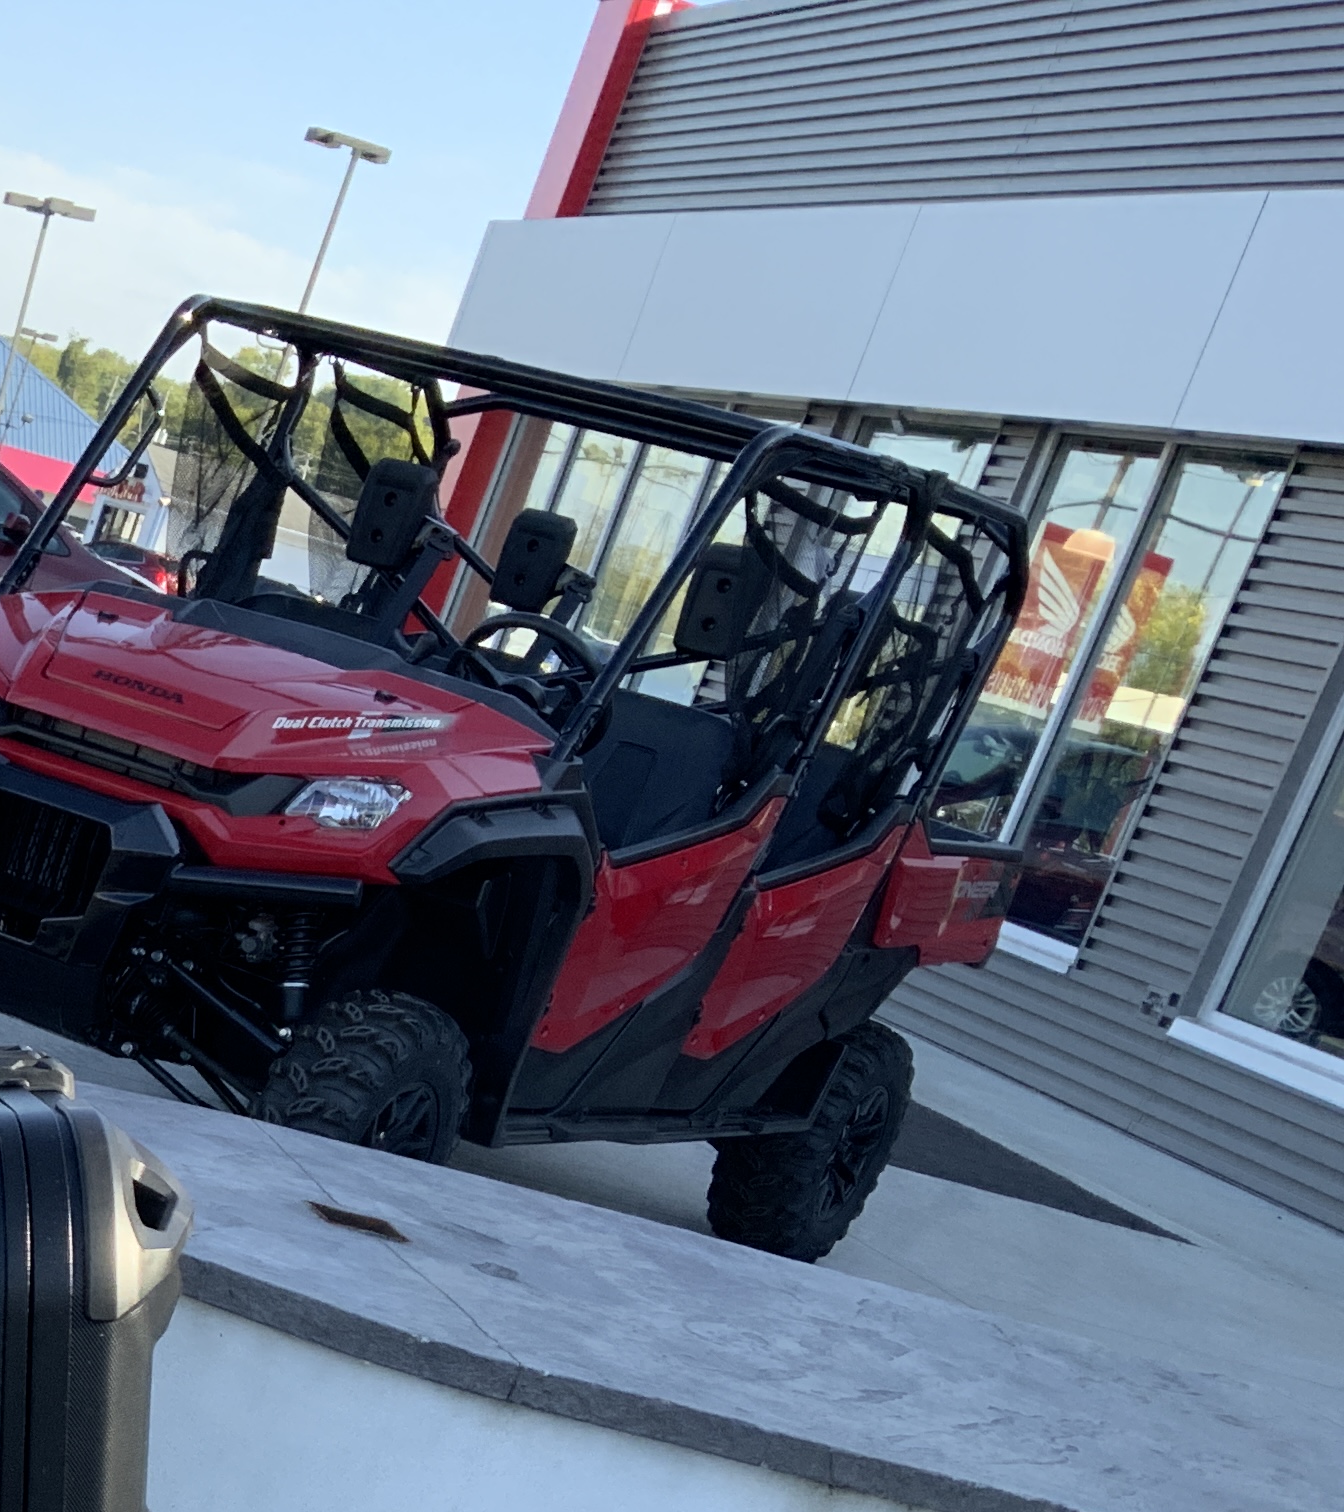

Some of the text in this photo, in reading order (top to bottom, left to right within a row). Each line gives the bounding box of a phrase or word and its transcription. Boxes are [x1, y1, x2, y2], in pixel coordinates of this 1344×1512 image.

[94, 667, 185, 705] HONDA
[271, 716, 442, 730] Dual Clutch Transmission
